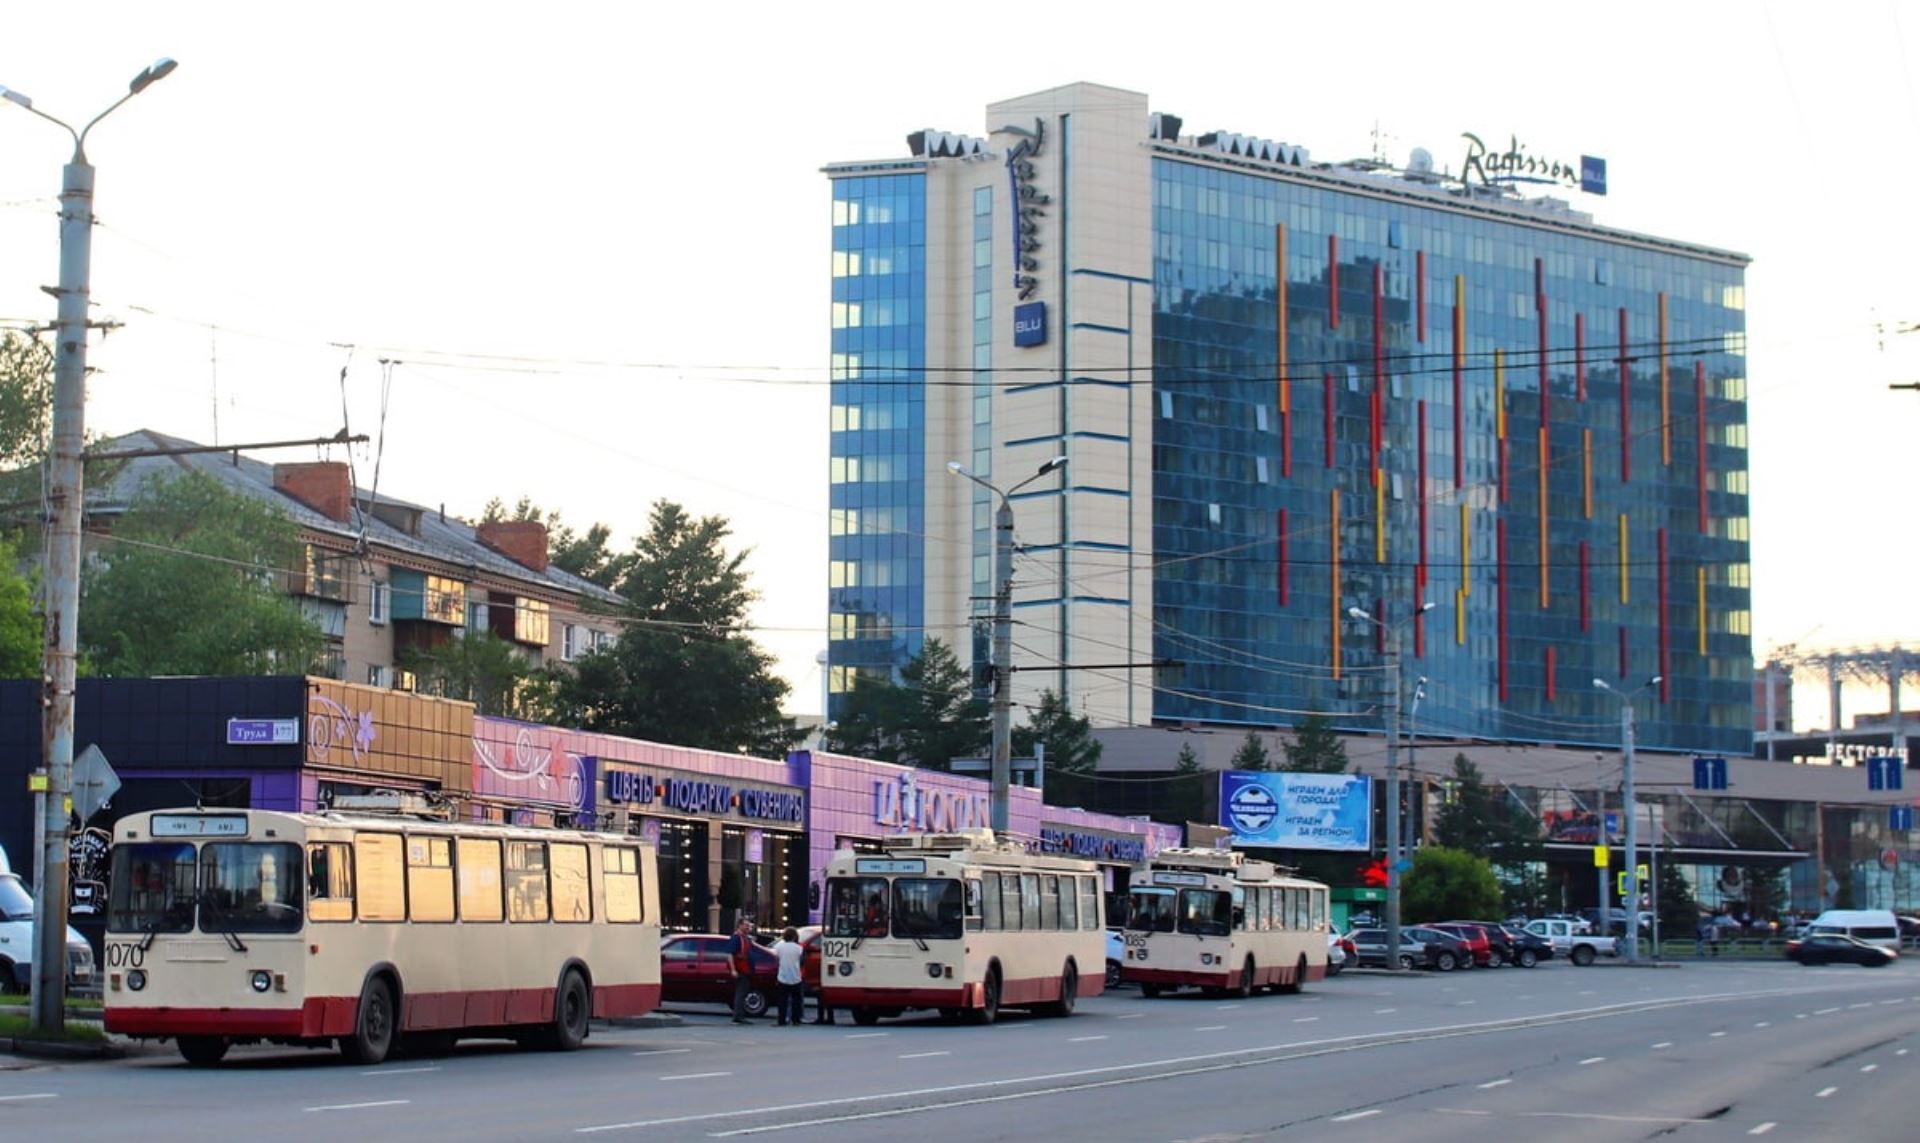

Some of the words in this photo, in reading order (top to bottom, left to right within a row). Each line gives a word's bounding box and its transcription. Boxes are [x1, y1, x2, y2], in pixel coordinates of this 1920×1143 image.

[1460, 132, 1578, 187] Radisson
[989, 116, 1049, 301] Radisson
[1015, 317, 1041, 334] BLU
[235, 727, 267, 739] Труда
[610, 771, 655, 802] ЦВЕТЫ
[667, 778, 731, 813] ПОДАРКИ
[741, 789, 804, 823] СУВЕНИРЫ
[1287, 785, 1325, 795] ИГРАЕМ
[1327, 786, 1348, 796] ДЛЯ
[1296, 794, 1338, 805] ГОРОДА!
[198, 820, 206, 833] 7
[1285, 815, 1323, 825] ИГРАЕМ
[1297, 827, 1309, 836] ЗА
[1312, 828, 1353, 838] РЕГИОН!
[1125, 933, 1147, 948] 1085
[106, 942, 145, 968] 1070
[824, 940, 850, 957] 1021
